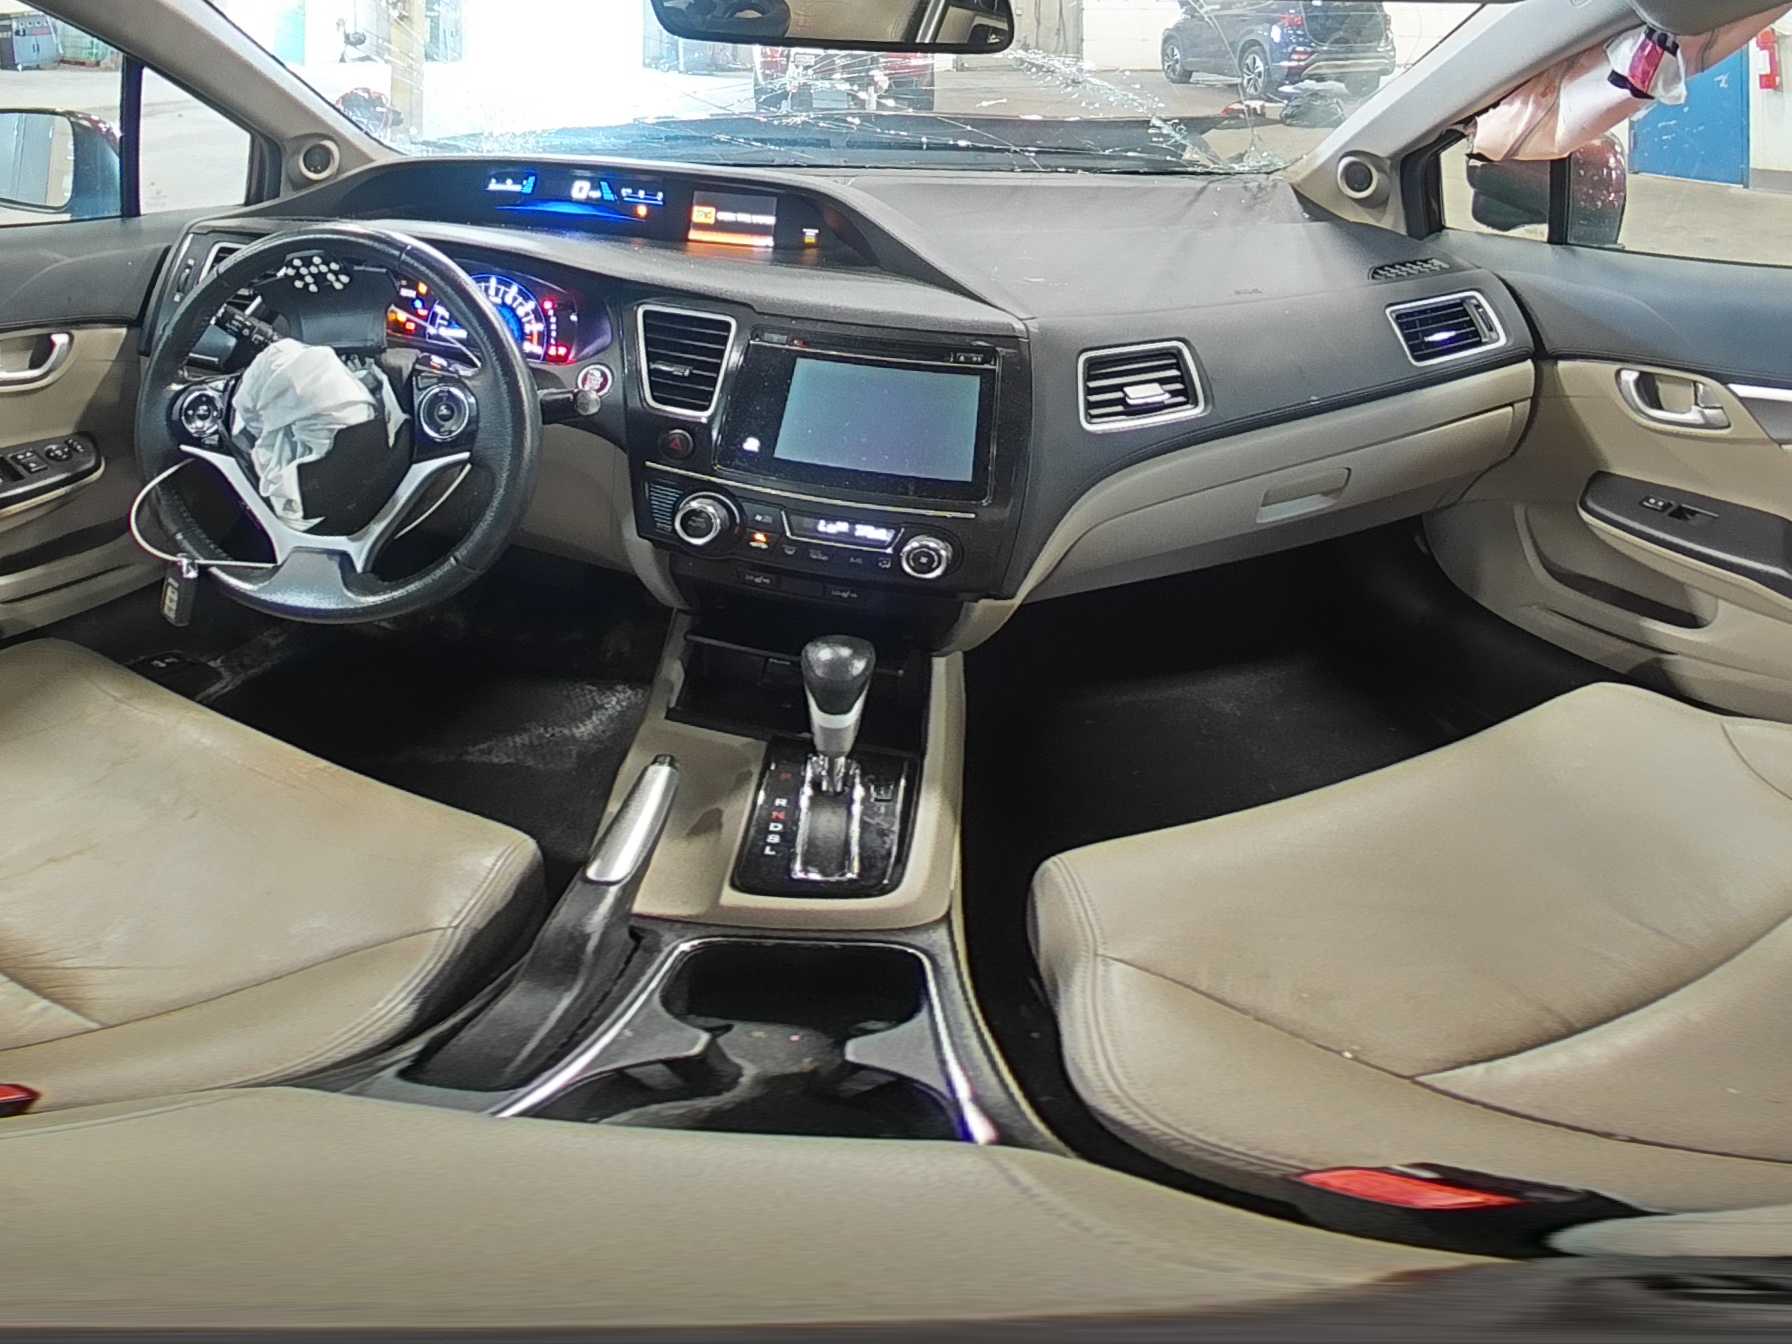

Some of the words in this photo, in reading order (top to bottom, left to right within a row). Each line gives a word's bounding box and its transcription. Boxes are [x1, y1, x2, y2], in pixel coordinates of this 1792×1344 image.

[775, 798, 786, 806] R
[769, 823, 782, 831] D
[767, 834, 780, 842] S
[765, 846, 776, 854] L
